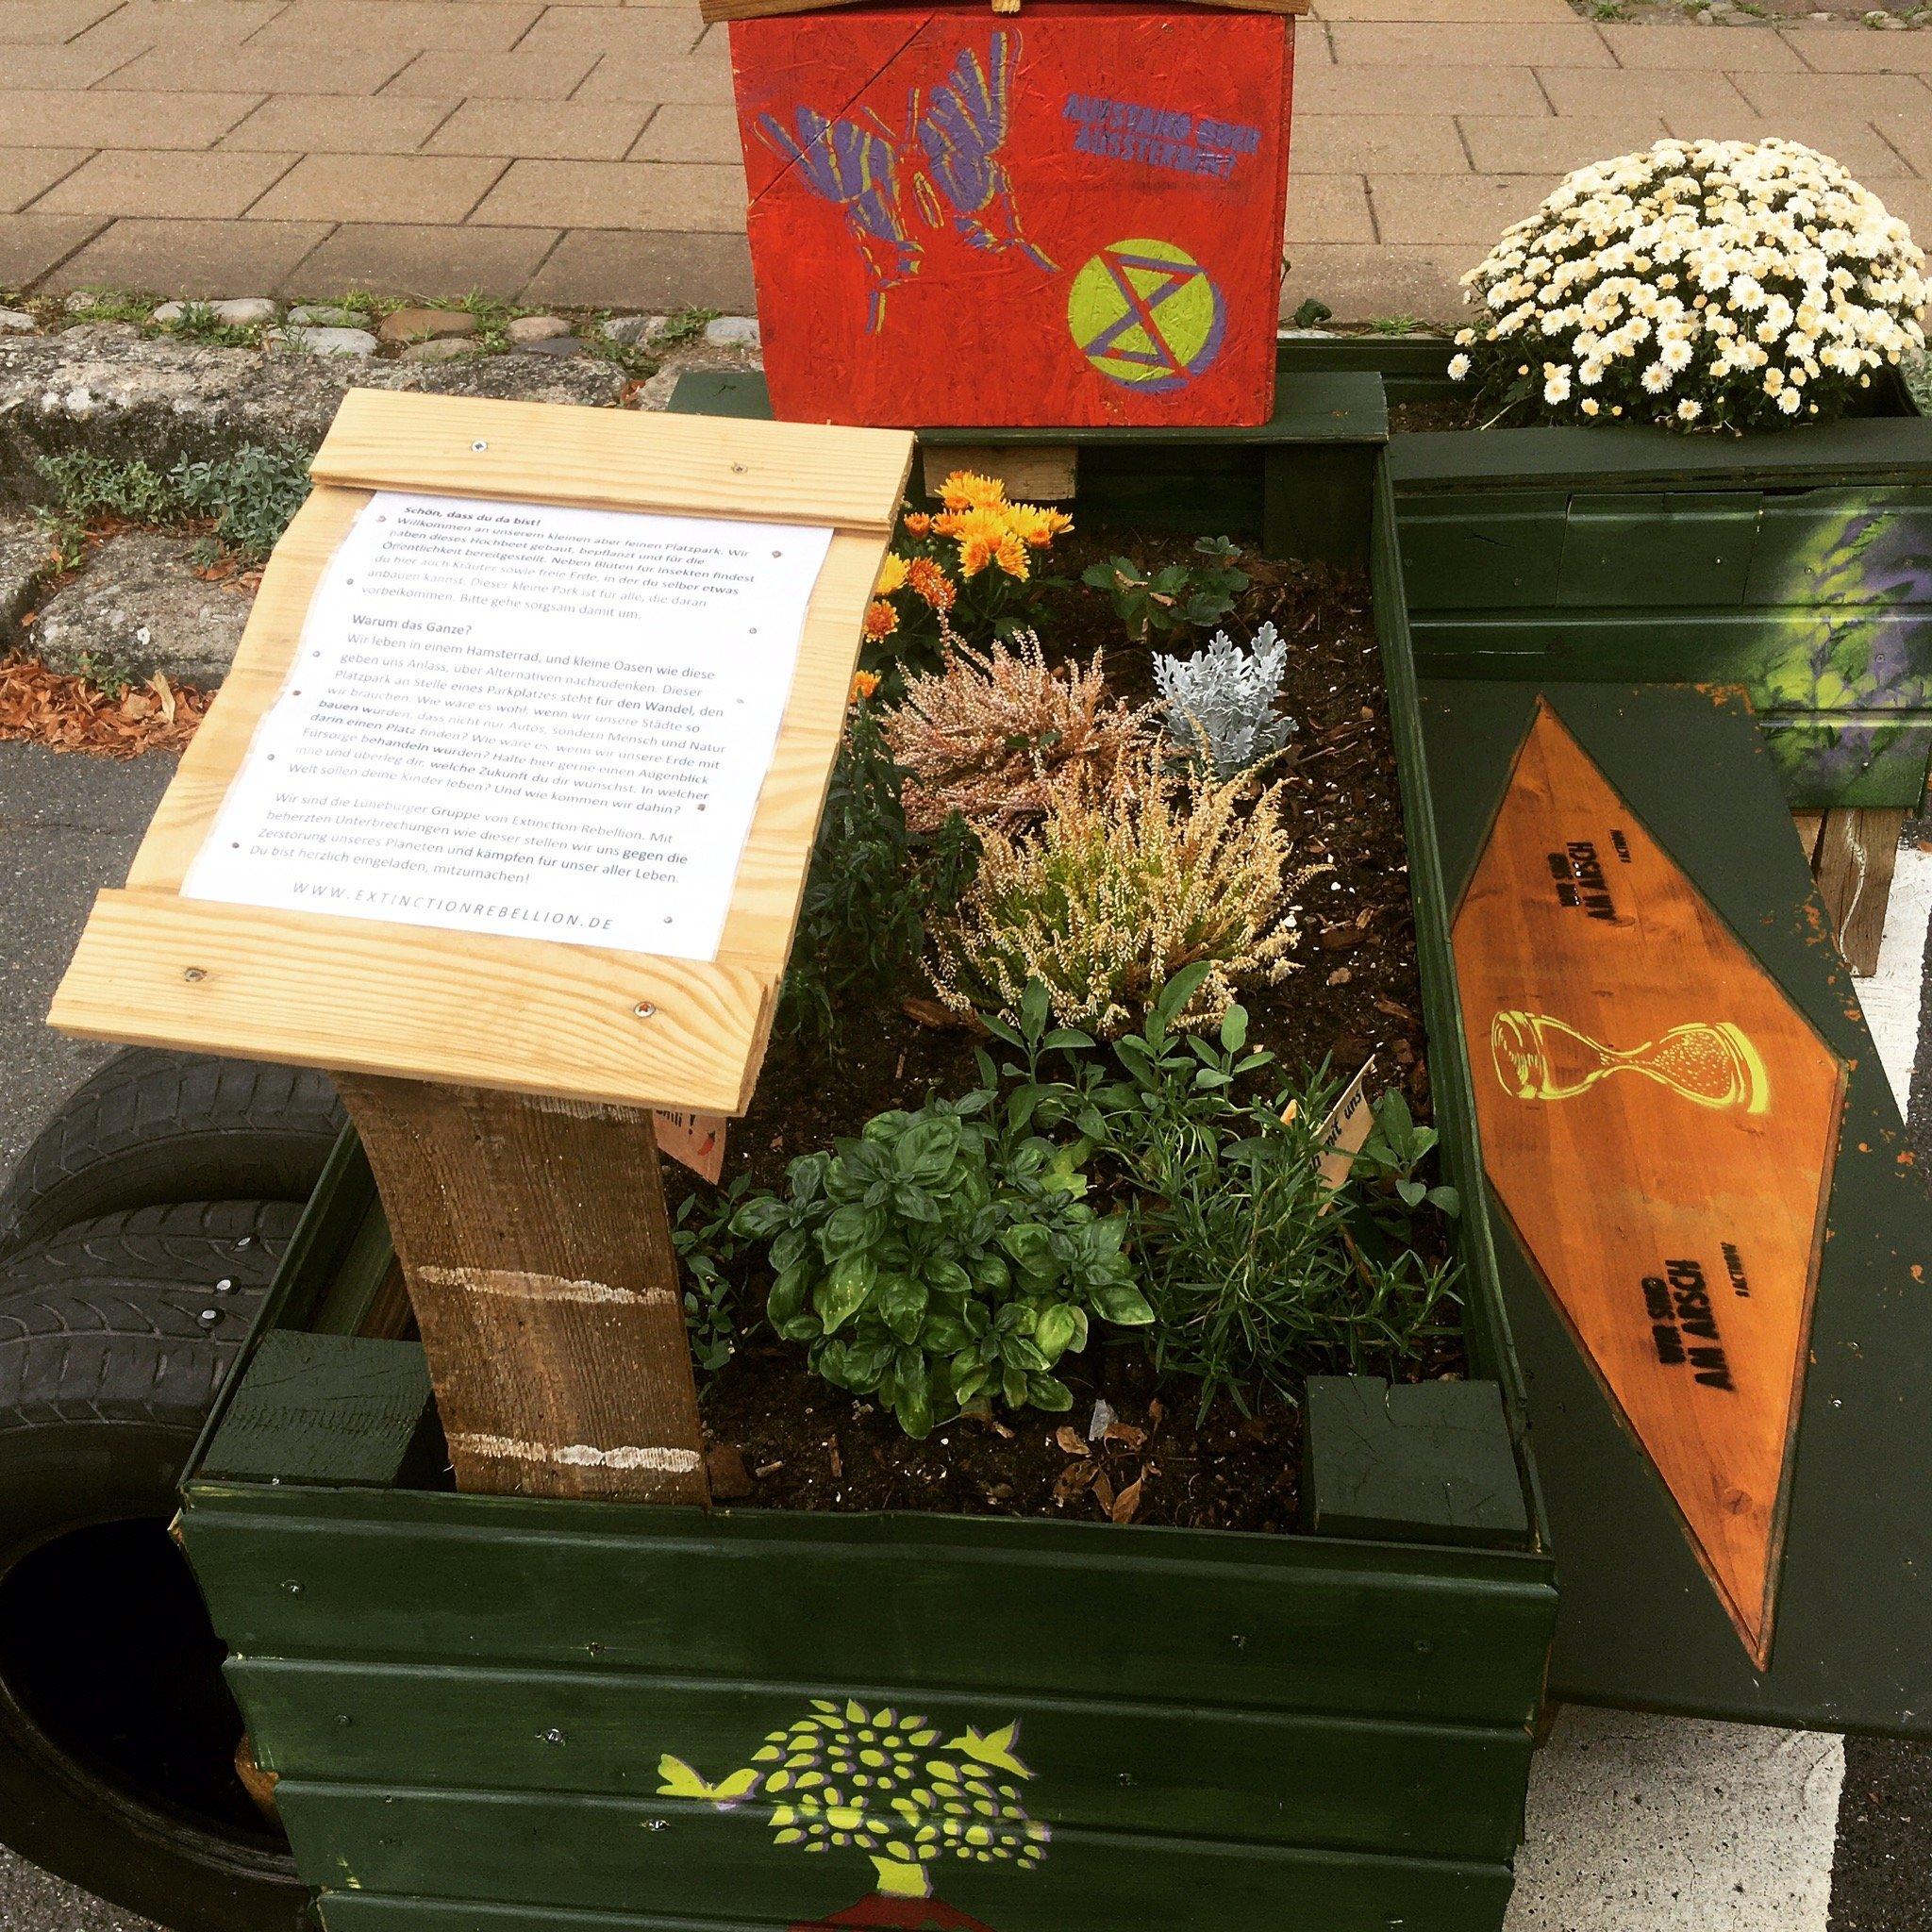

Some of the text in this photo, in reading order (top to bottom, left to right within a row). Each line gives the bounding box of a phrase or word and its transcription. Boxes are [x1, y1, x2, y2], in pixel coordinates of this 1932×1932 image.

[396, 517, 472, 531] Willkommen
[491, 528, 544, 539] unserem
[546, 532, 591, 543] kleinen
[592, 537, 621, 545] aber
[624, 540, 662, 549] feinen
[727, 548, 749, 557] Wir
[445, 510, 474, 520] dass
[475, 513, 492, 522] du
[494, 515, 510, 524] da
[512, 517, 541, 526] bist!
[428, 532, 467, 542] dieses
[469, 537, 528, 549] Hochbeet
[578, 546, 636, 558] bepflanzt
[685, 557, 705, 565] die
[550, 556, 591, 566] Neben
[657, 566, 709, 577] Insekten
[712, 571, 755, 582] findest
[603, 574, 615, 583] in
[618, 575, 640, 585] der
[641, 577, 658, 587] du
[661, 580, 699, 591] selber
[701, 585, 739, 594] etwas
[490, 597, 522, 608] gehe
[577, 604, 615, 617] damit
[670, 595, 707, 608] daran
[352, 613, 473, 635] Warum das Ganze?
[371, 635, 407, 648] leben
[424, 642, 463, 654] einem
[545, 655, 571, 665] und
[573, 655, 610, 669] kleine
[613, 659, 653, 674] Oasen
[656, 665, 678, 676] wie
[680, 666, 715, 679] diese
[449, 683, 484, 693] eines
[486, 685, 557, 700] Parkplatzes
[559, 692, 593, 705] steht
[616, 698, 641, 709] den
[698, 706, 724, 717] den
[485, 666, 562, 683] Alternativen
[661, 684, 702, 697] Dieser
[317, 699, 358, 711] bauen
[607, 731, 658, 745] Mensch
[660, 739, 688, 749] und
[689, 741, 725, 753] Natur
[416, 694, 441, 706] Wie
[533, 708, 568, 718] wenn
[685, 724, 701, 733] so
[309, 712, 721, 770] darin einen Platz Wie unsere Erde mit
[360, 734, 708, 784] behandeln Halte hier einen Augenblick
[289, 762, 318, 774] Welt
[445, 777, 491, 791] leben?
[493, 784, 523, 796] Und
[524, 790, 548, 799] wie
[550, 791, 608, 807] kommen
[611, 800, 634, 809] wir
[635, 801, 681, 814] dahin?
[429, 761, 475, 774] welche
[477, 766, 528, 780] Zukunft
[530, 773, 549, 783] du
[641, 785, 654, 794] In
[657, 788, 709, 800] welcher
[275, 792, 299, 803] Wir
[430, 806, 481, 821] Gruppe
[511, 814, 577, 832] Extinction
[649, 831, 673, 843] Mit
[335, 815, 450, 835] Unterbrechungen
[453, 827, 477, 838] wie
[479, 829, 521, 843] dieser
[524, 836, 568, 849] stellen
[571, 842, 593, 852] wir
[595, 845, 620, 856] uns
[621, 849, 664, 861] gegen
[666, 852, 688, 864] die
[385, 837, 443, 853] Planeten
[446, 845, 475, 857] und
[560, 860, 600, 872] unser
[601, 863, 632, 876] aller
[433, 864, 531, 883] mitzumachen!
[293, 882, 612, 929] WWW.EXTINCTIONREBELLION.DE
